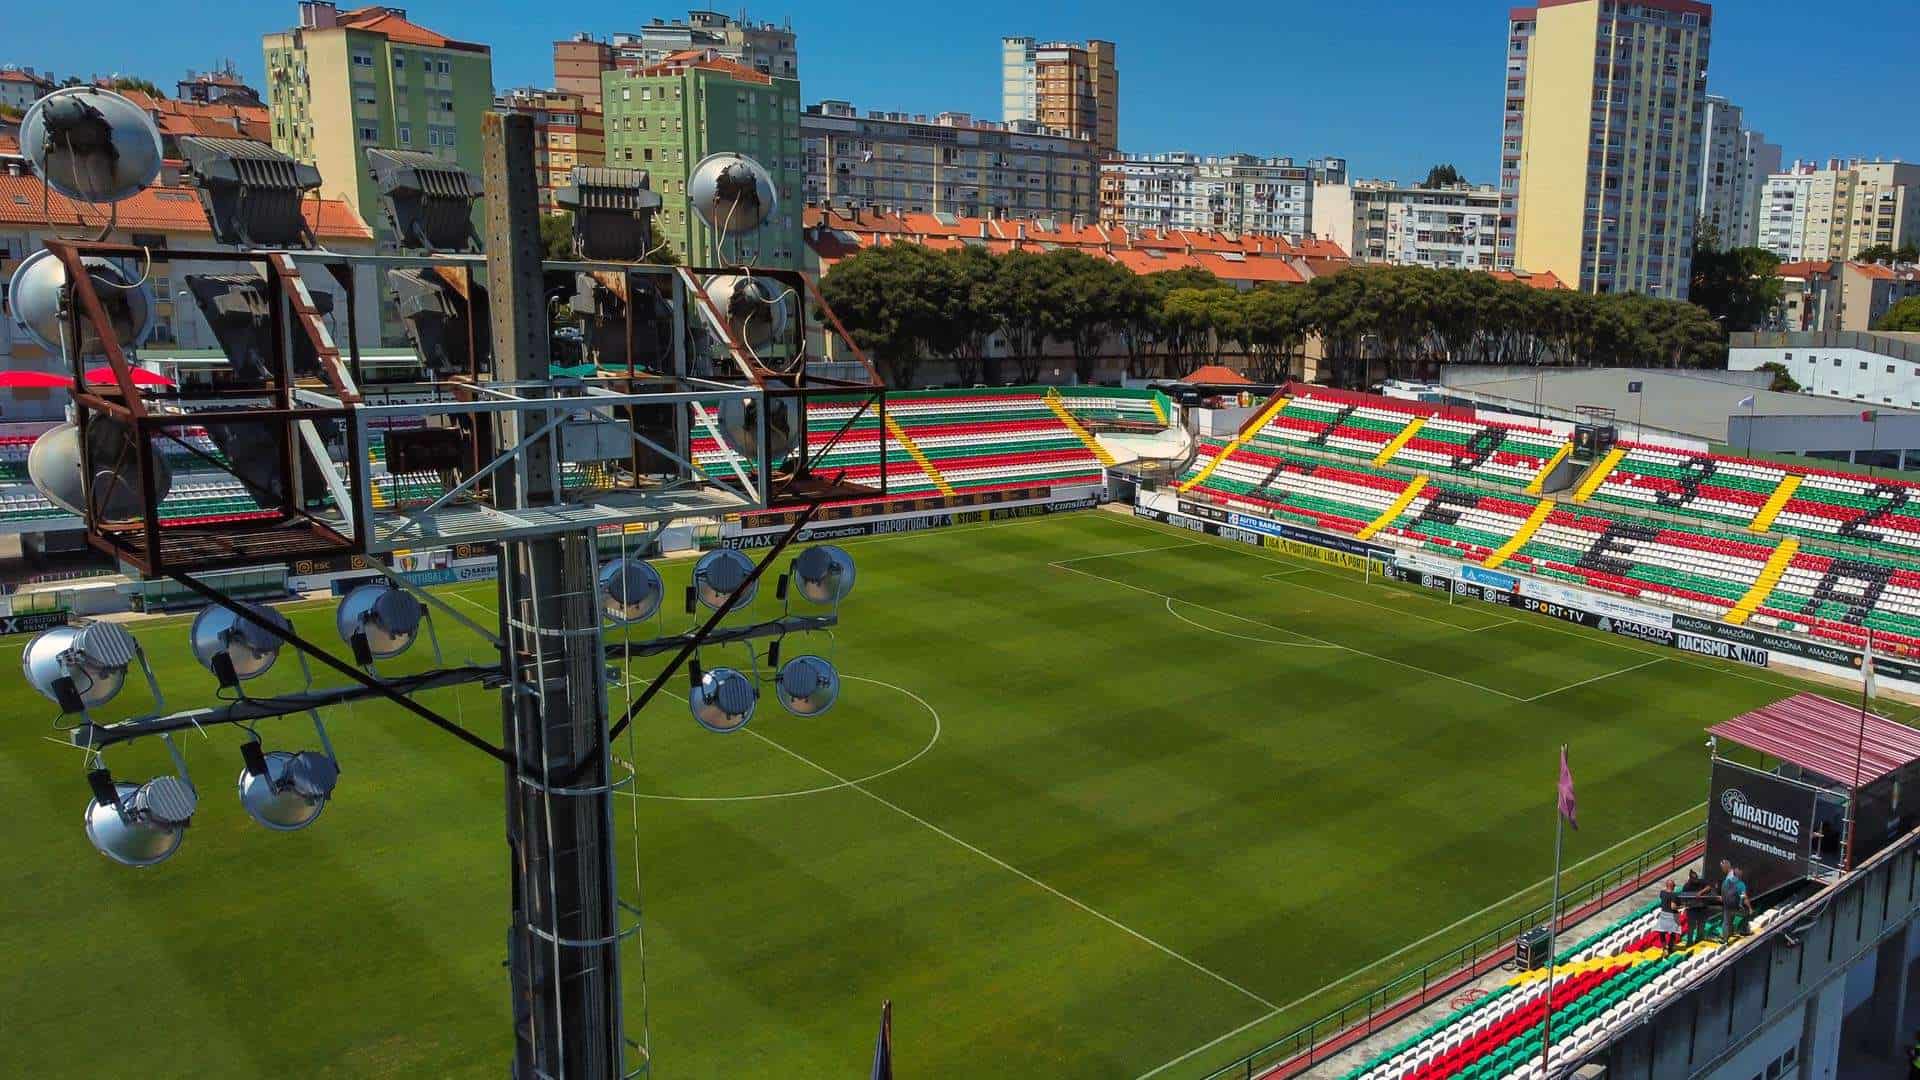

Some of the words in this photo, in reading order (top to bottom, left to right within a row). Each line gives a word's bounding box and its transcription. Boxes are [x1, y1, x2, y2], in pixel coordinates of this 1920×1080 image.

[722, 535, 772, 550] RE/MAX
[1613, 619, 1674, 641] AMADORA
[1678, 634, 1729, 658] RACISMO
[1732, 801, 1800, 836] MIRATUBOS
